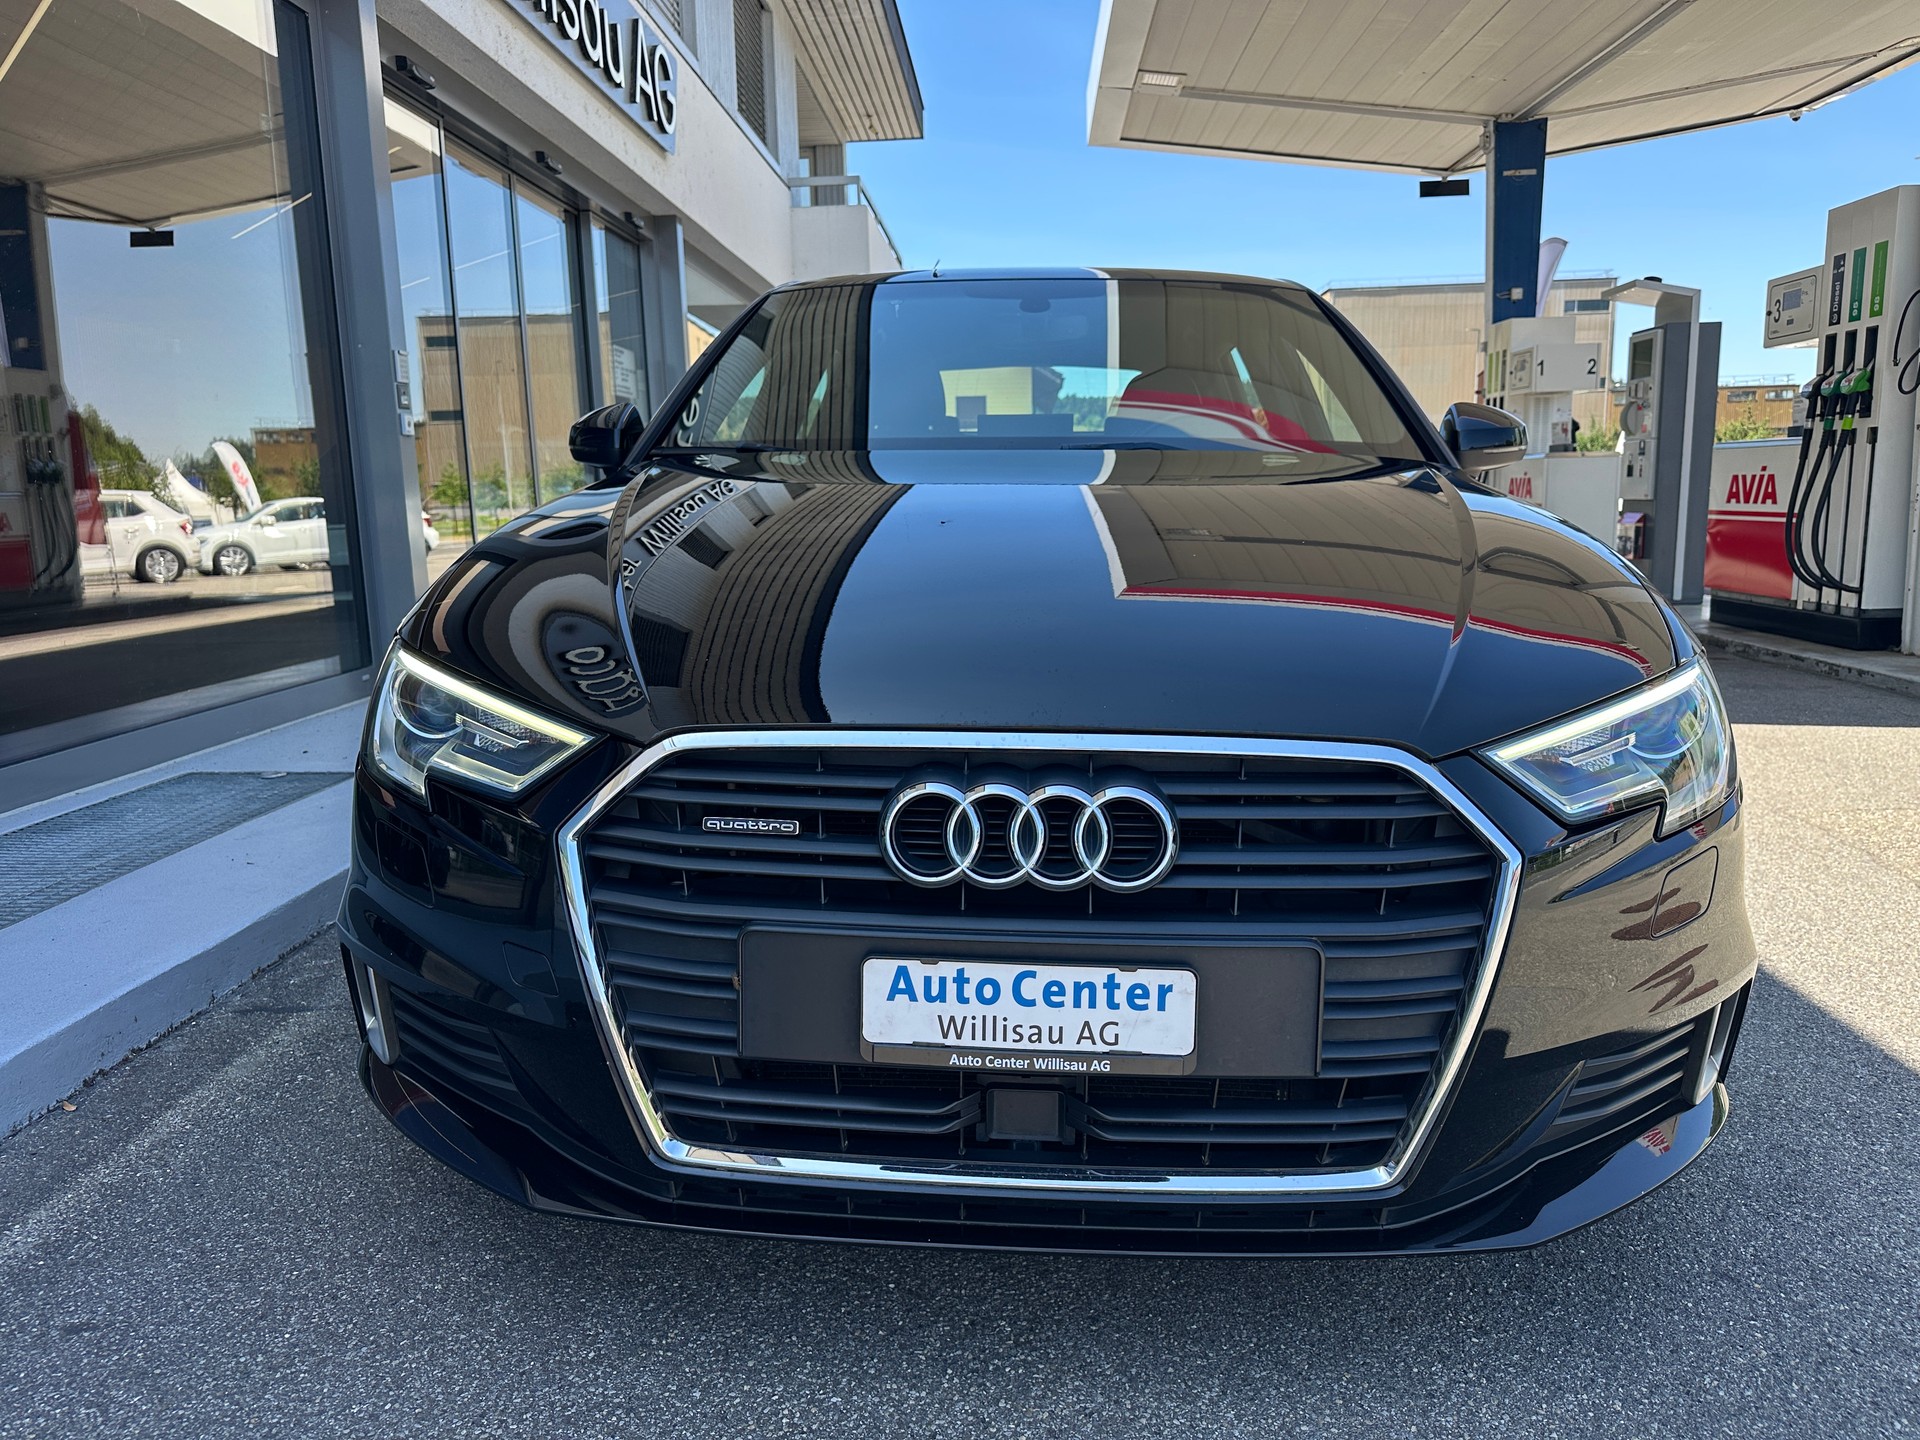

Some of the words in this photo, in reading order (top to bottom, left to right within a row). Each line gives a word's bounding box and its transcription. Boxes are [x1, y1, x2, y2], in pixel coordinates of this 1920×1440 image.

[633, 18, 677, 134] AG
[1772, 299, 1781, 323] 3
[1536, 360, 1544, 376] 1
[1587, 358, 1597, 375] 2
[706, 820, 794, 831] quattro
[886, 965, 1002, 1006] Auto
[1012, 970, 1174, 1013] Center
[937, 1015, 1064, 1046] Willisau
[1076, 1021, 1120, 1047] AG
[950, 1054, 982, 1067] Auto
[985, 1055, 1030, 1069] Center
[1033, 1057, 1087, 1071] Willisau
[1090, 1060, 1111, 1072] AG
